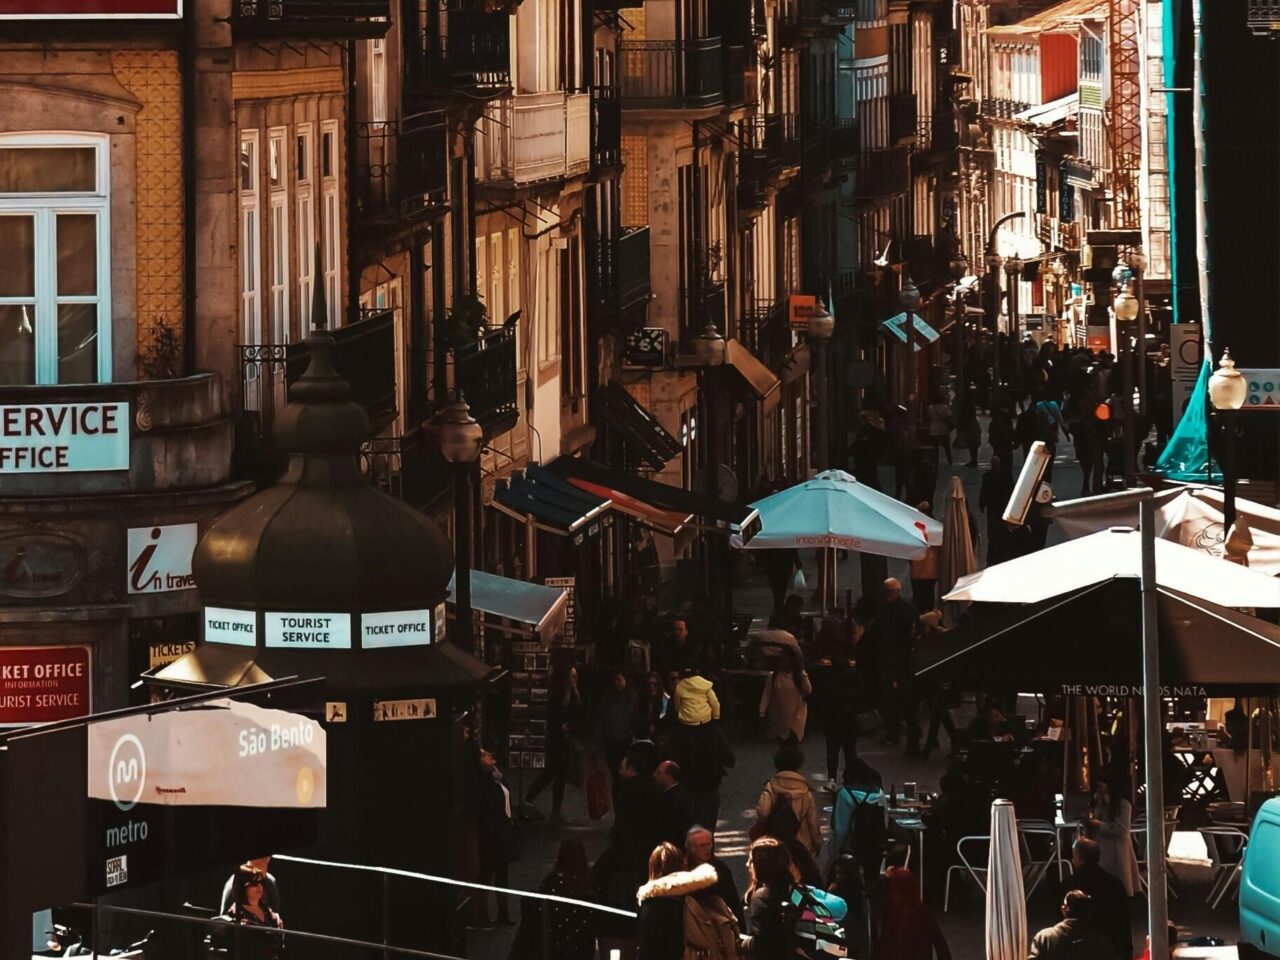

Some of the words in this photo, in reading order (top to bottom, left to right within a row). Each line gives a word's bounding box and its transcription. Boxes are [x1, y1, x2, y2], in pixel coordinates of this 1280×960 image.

[166, 572, 197, 589] trave
[208, 619, 231, 631] TICKET
[232, 621, 254, 634] OFFICE
[280, 617, 331, 629] TOURIST
[365, 624, 395, 636] TICKET
[397, 622, 427, 634] OFFICE
[282, 631, 330, 643] SERVICE
[152, 642, 193, 657] TICKETS
[34, 663, 83, 678] OFFICE
[5, 680, 59, 689] INFORMATION
[1062, 684, 1081, 695] THE
[1085, 685, 1129, 696] WORLD
[1174, 686, 1206, 696] NATA
[36, 693, 80, 707] SERVICE
[239, 728, 266, 757] São
[271, 723, 313, 751] Bento
[106, 819, 148, 848] metro
